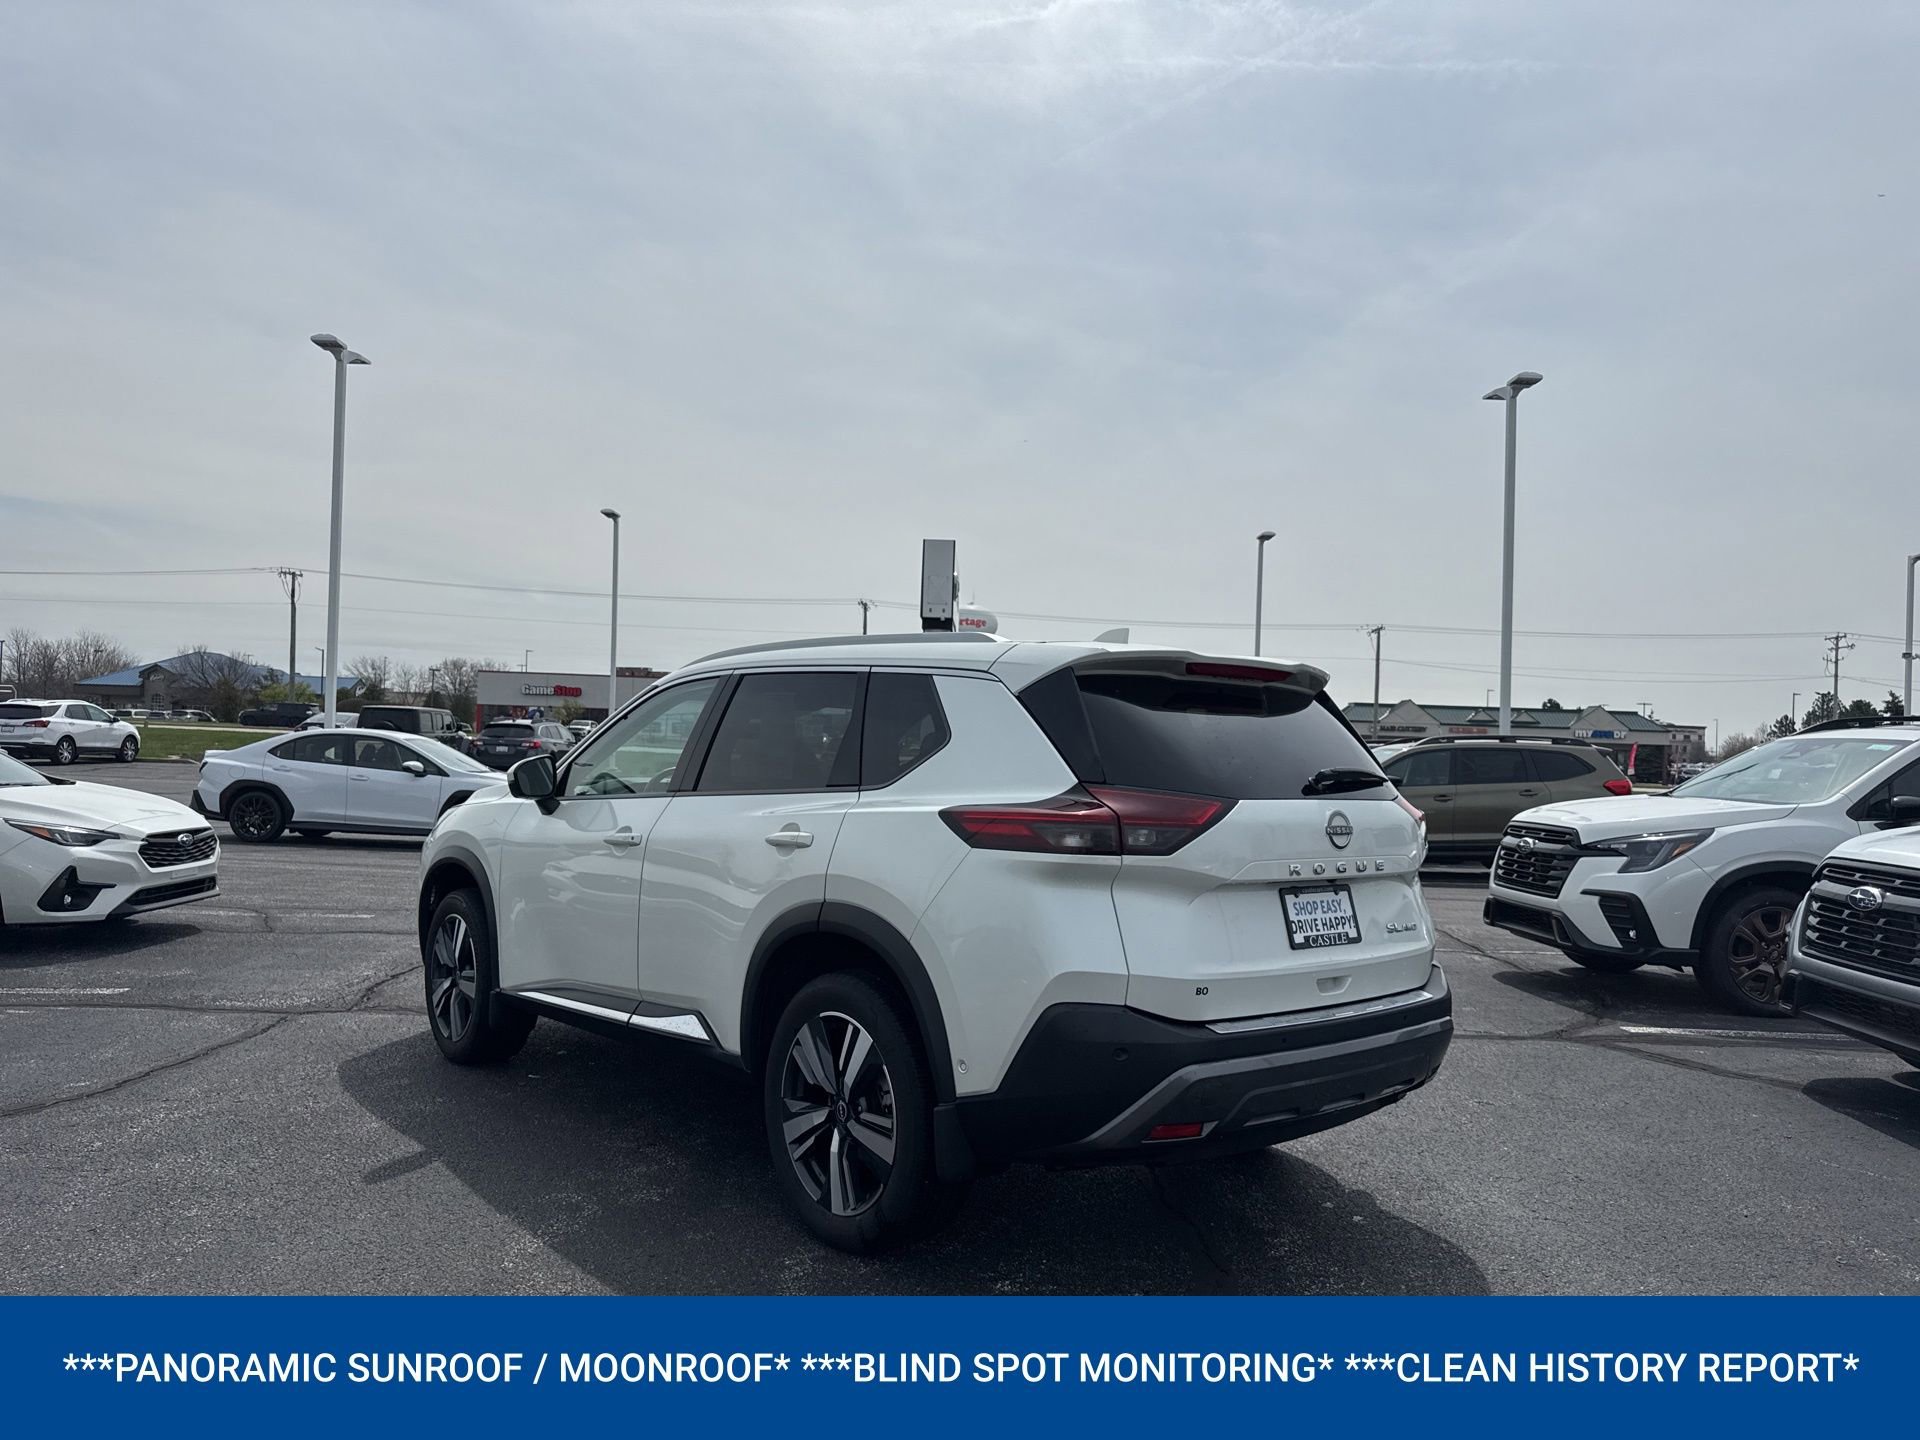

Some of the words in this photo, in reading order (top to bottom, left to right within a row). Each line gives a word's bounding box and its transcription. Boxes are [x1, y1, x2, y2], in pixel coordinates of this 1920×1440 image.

[959, 618, 987, 628] rtage
[521, 685, 582, 696] GameStop
[1288, 860, 1385, 876] ROGUE
[1293, 901, 1319, 916] SHOP
[1321, 899, 1346, 914] EASY,
[1291, 918, 1320, 934] DRIVE
[1321, 915, 1356, 932] HAPPY!
[1309, 933, 1348, 947] CASTLE
